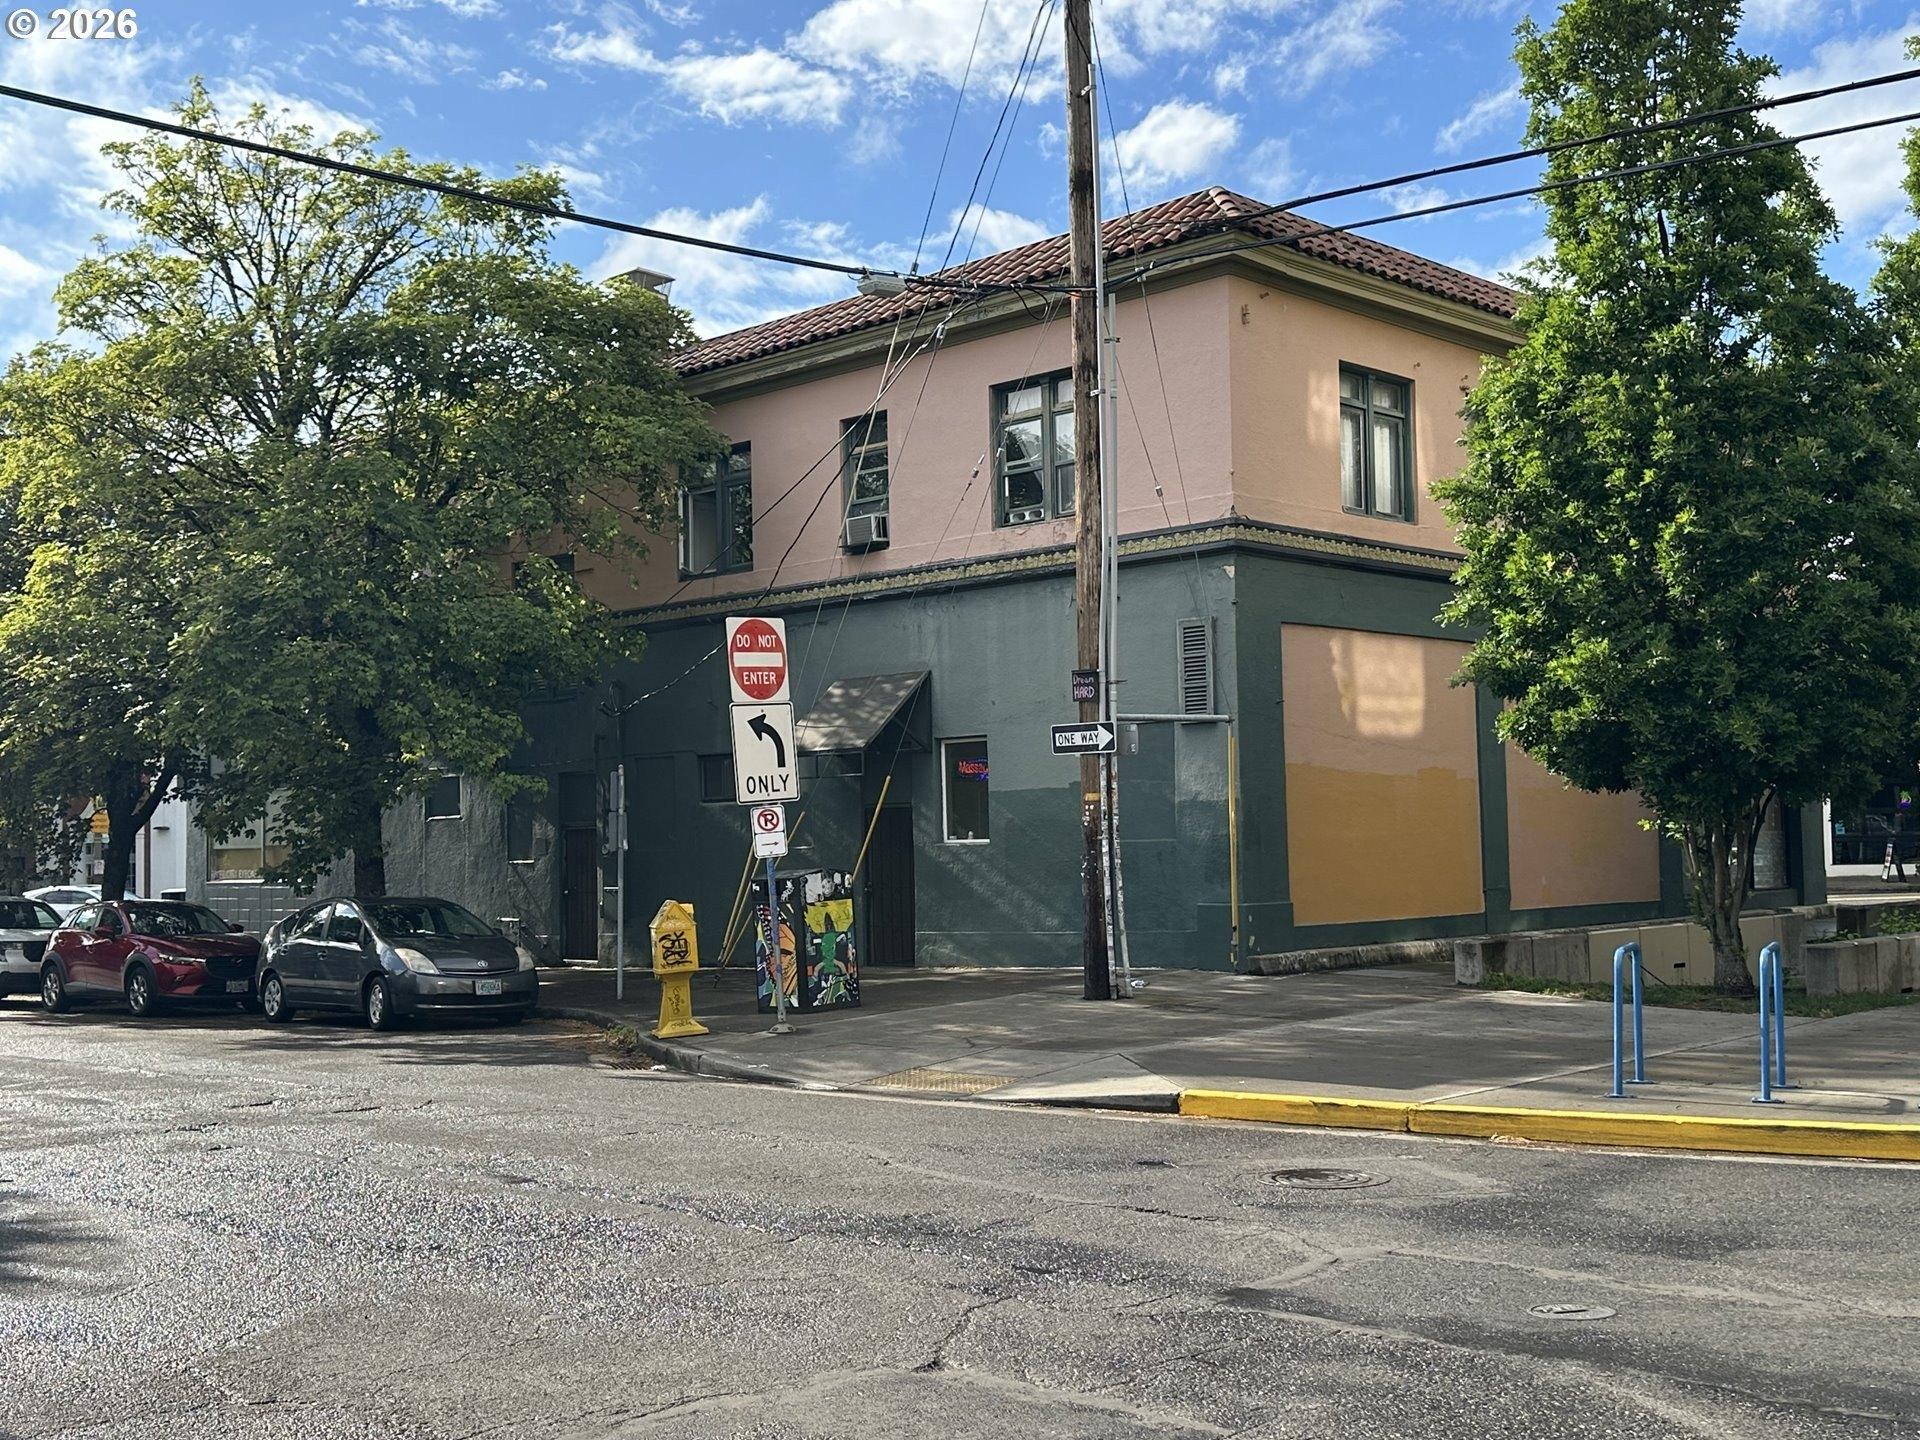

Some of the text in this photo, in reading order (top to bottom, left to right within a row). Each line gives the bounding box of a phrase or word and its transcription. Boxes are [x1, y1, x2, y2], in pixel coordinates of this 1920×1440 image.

[736, 634, 777, 648] DO NOT
[743, 671, 777, 685] ENTER
[1073, 686, 1095, 699] HARD
[1058, 732, 1099, 745] ONE WAY
[746, 773, 790, 795] ONLY
